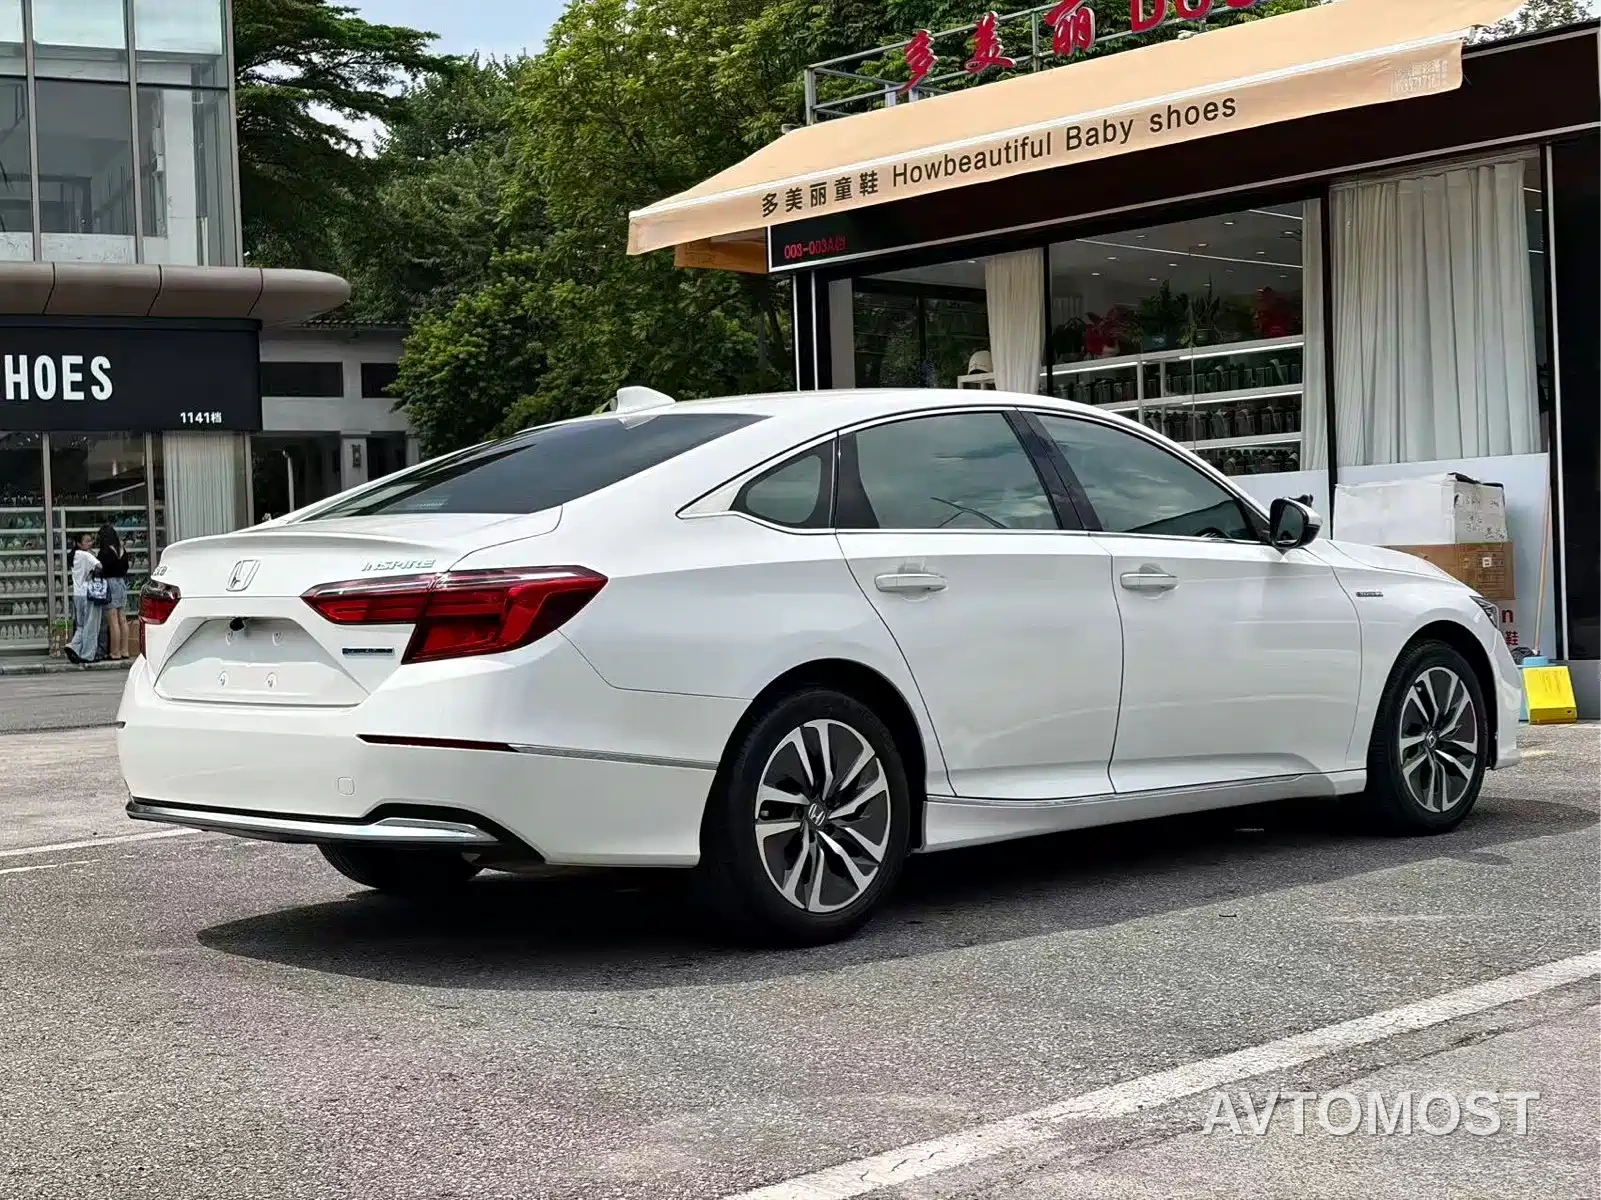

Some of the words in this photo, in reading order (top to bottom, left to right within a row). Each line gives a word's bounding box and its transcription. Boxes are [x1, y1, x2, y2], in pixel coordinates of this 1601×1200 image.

[761, 171, 879, 218] 多美丽童鞋
[892, 132, 1052, 187] Howbeautiful
[1066, 118, 1134, 151] Baby
[1149, 97, 1237, 133] shoes
[4, 354, 113, 401] HOES
